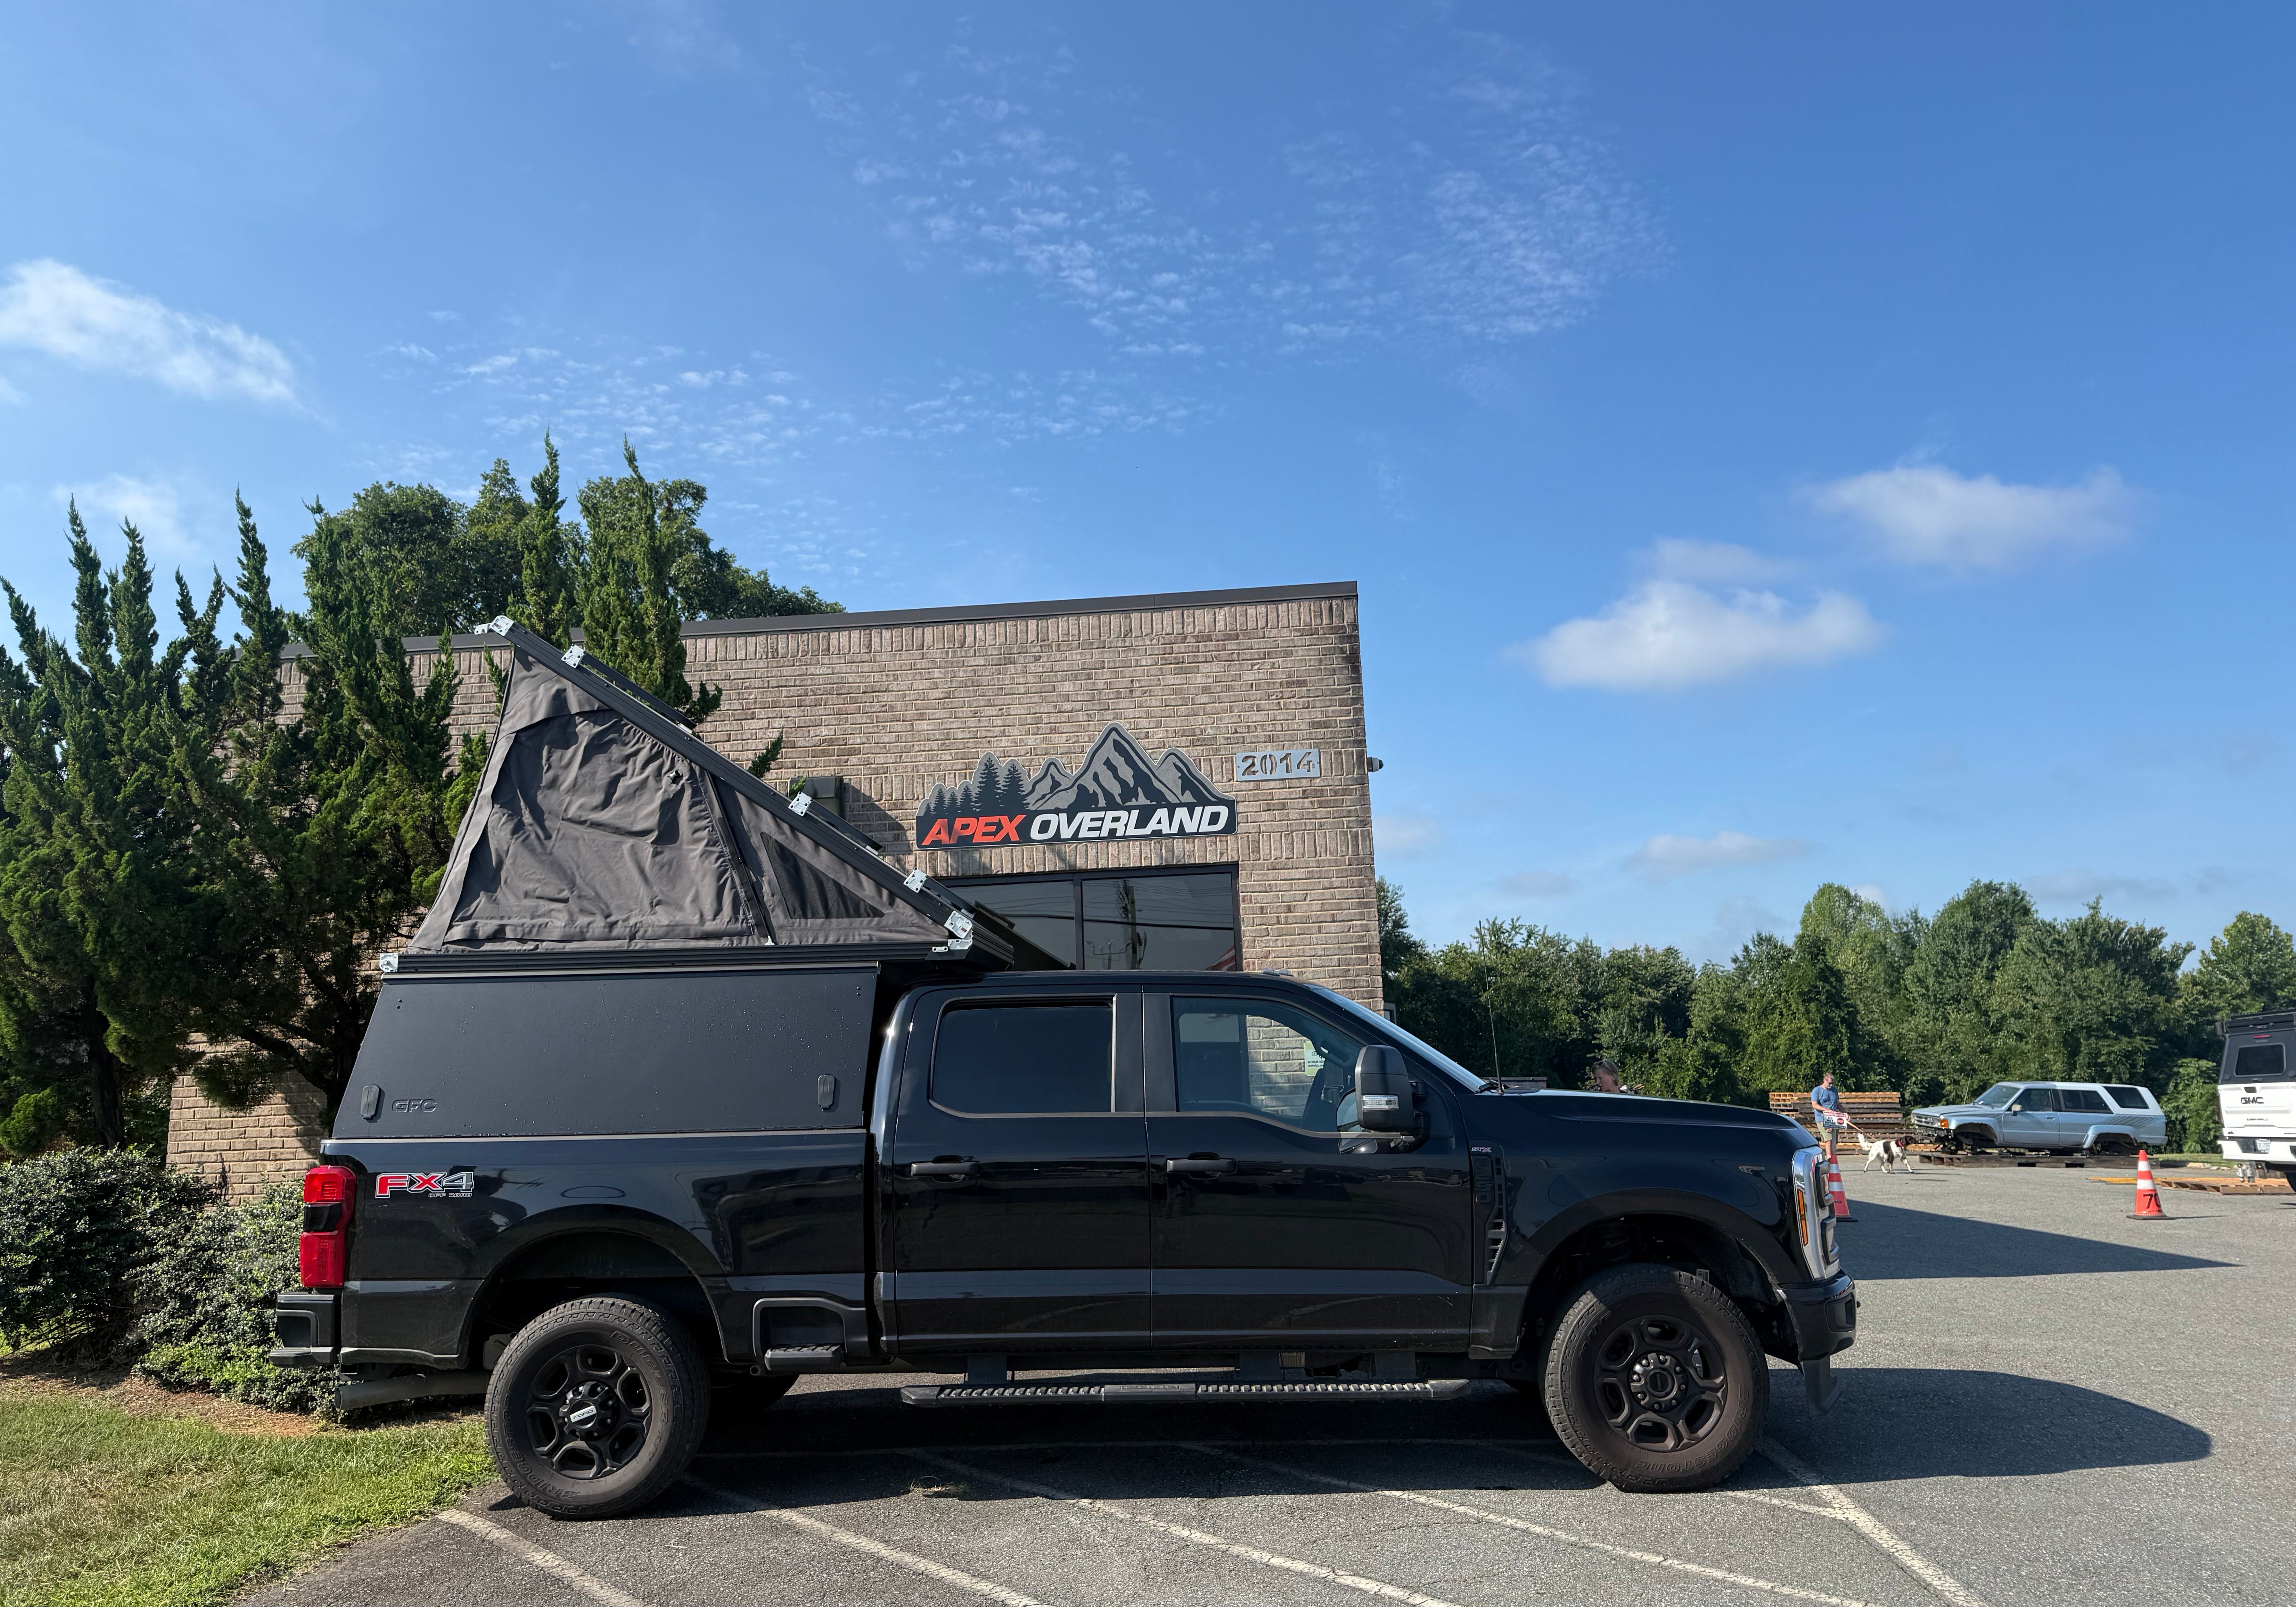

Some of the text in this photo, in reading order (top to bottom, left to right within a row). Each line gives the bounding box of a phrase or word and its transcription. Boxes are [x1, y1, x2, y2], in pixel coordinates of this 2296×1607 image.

[1242, 752, 1315, 776] 2014
[921, 805, 1229, 846] APEX OVERLAND
[392, 1099, 437, 1113] GFC
[375, 1172, 474, 1198] FX4
[573, 1409, 593, 1419] FORD
[1635, 1384, 1749, 1472] BRIDGESTONE
